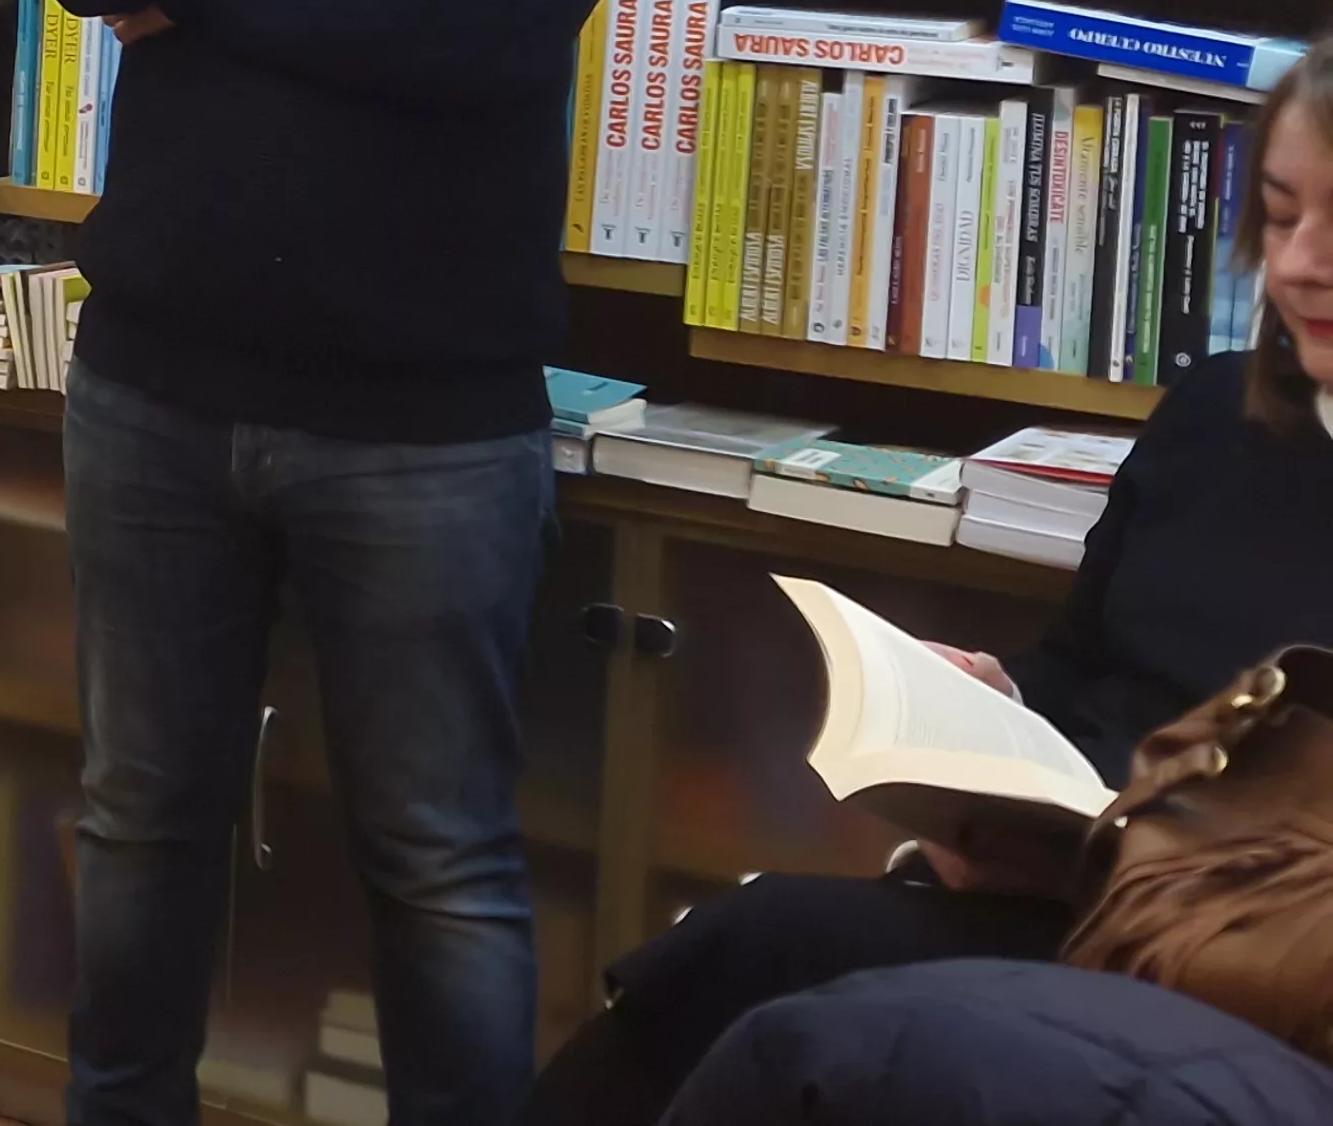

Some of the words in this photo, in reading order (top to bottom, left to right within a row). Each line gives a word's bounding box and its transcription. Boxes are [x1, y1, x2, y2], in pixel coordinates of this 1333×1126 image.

[44, 14, 59, 59] DYER
[64, 17, 78, 64] DYER
[648, 0, 673, 68] SAURA
[683, 1, 708, 71] SAURA
[734, 34, 810, 57] SAURA
[812, 39, 905, 66] CARLOS
[605, 69, 632, 148] CARLOS
[641, 72, 667, 151] CARLOS
[676, 74, 702, 154] CARLOS
